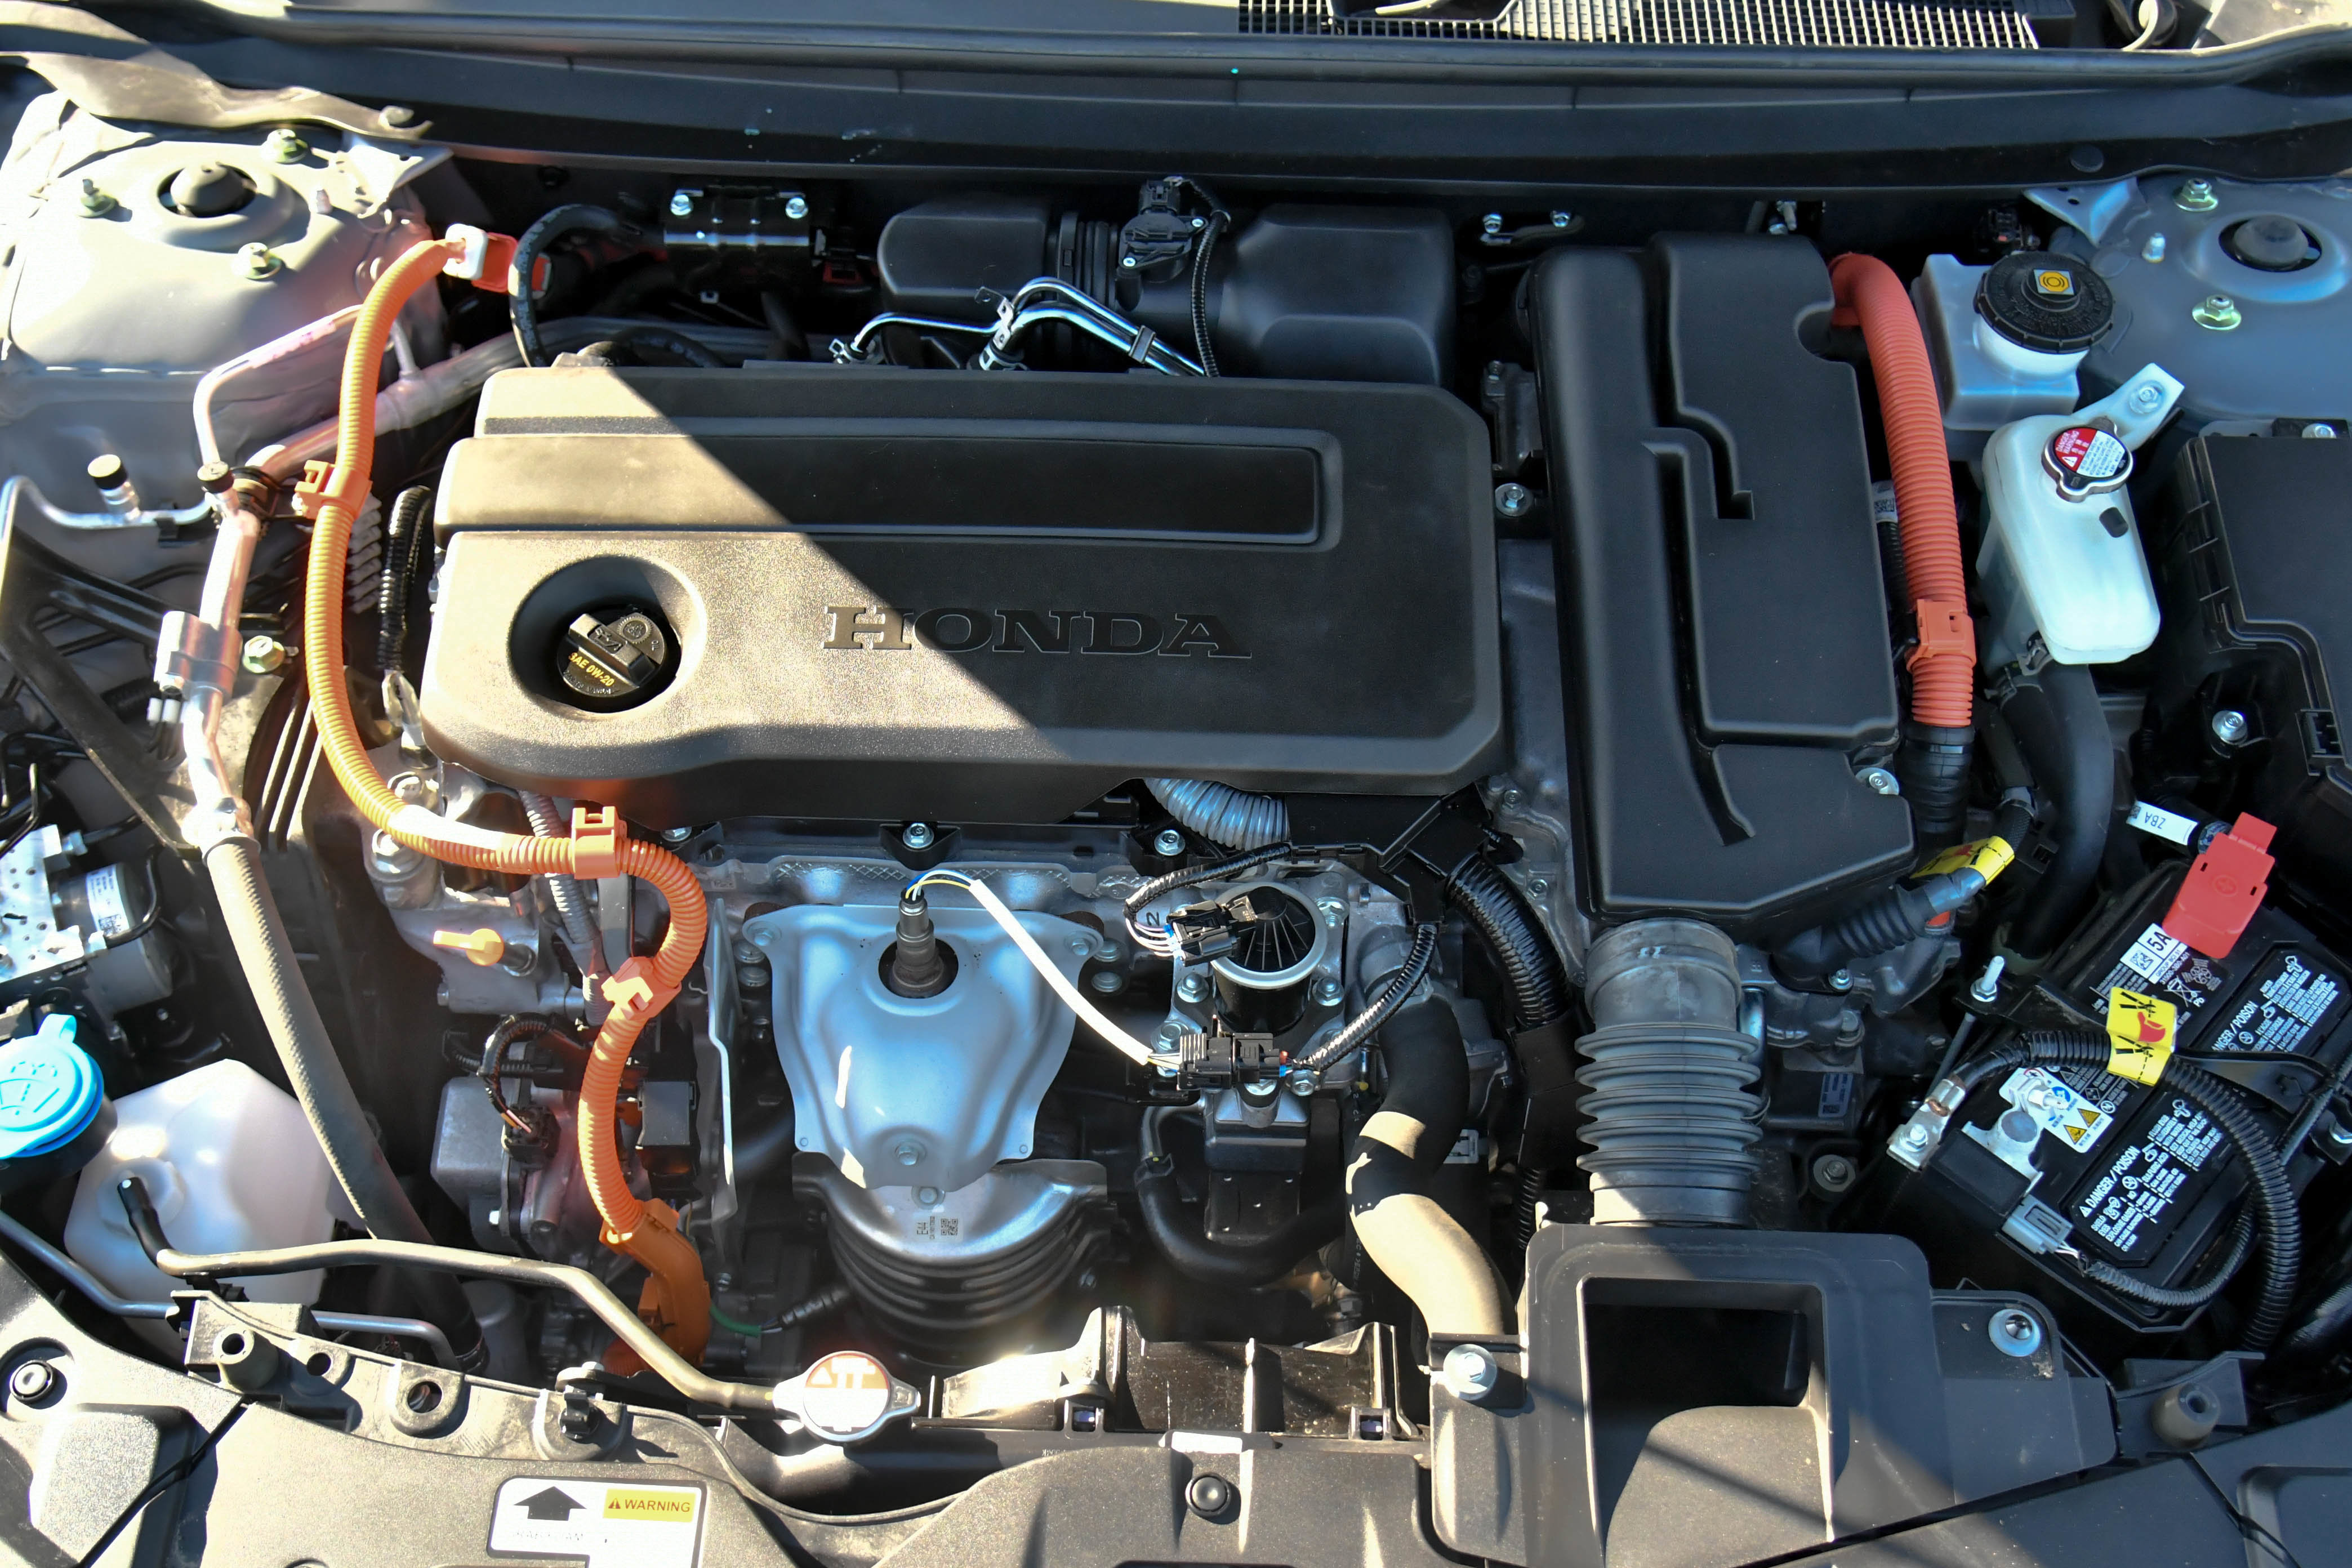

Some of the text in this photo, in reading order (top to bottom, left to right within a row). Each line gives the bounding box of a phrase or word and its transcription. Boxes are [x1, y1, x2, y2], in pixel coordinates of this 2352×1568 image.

[822, 606, 1252, 659] HONDA
[568, 652, 590, 669] SAE
[585, 664, 615, 687] 0W-20
[2144, 812, 2166, 828] ZBA
[2146, 926, 2173, 953] 5A
[2193, 995, 2205, 1008] Pb
[2211, 1028, 2235, 1050] ANGER
[2232, 999, 2259, 1028] POISON
[2084, 1175, 2115, 1208] DANGER
[2112, 1144, 2141, 1175] POISON
[916, 1222, 928, 1234] E44
[2090, 1214, 2107, 1232] SHIELD
[624, 1498, 690, 1512] WARNING
